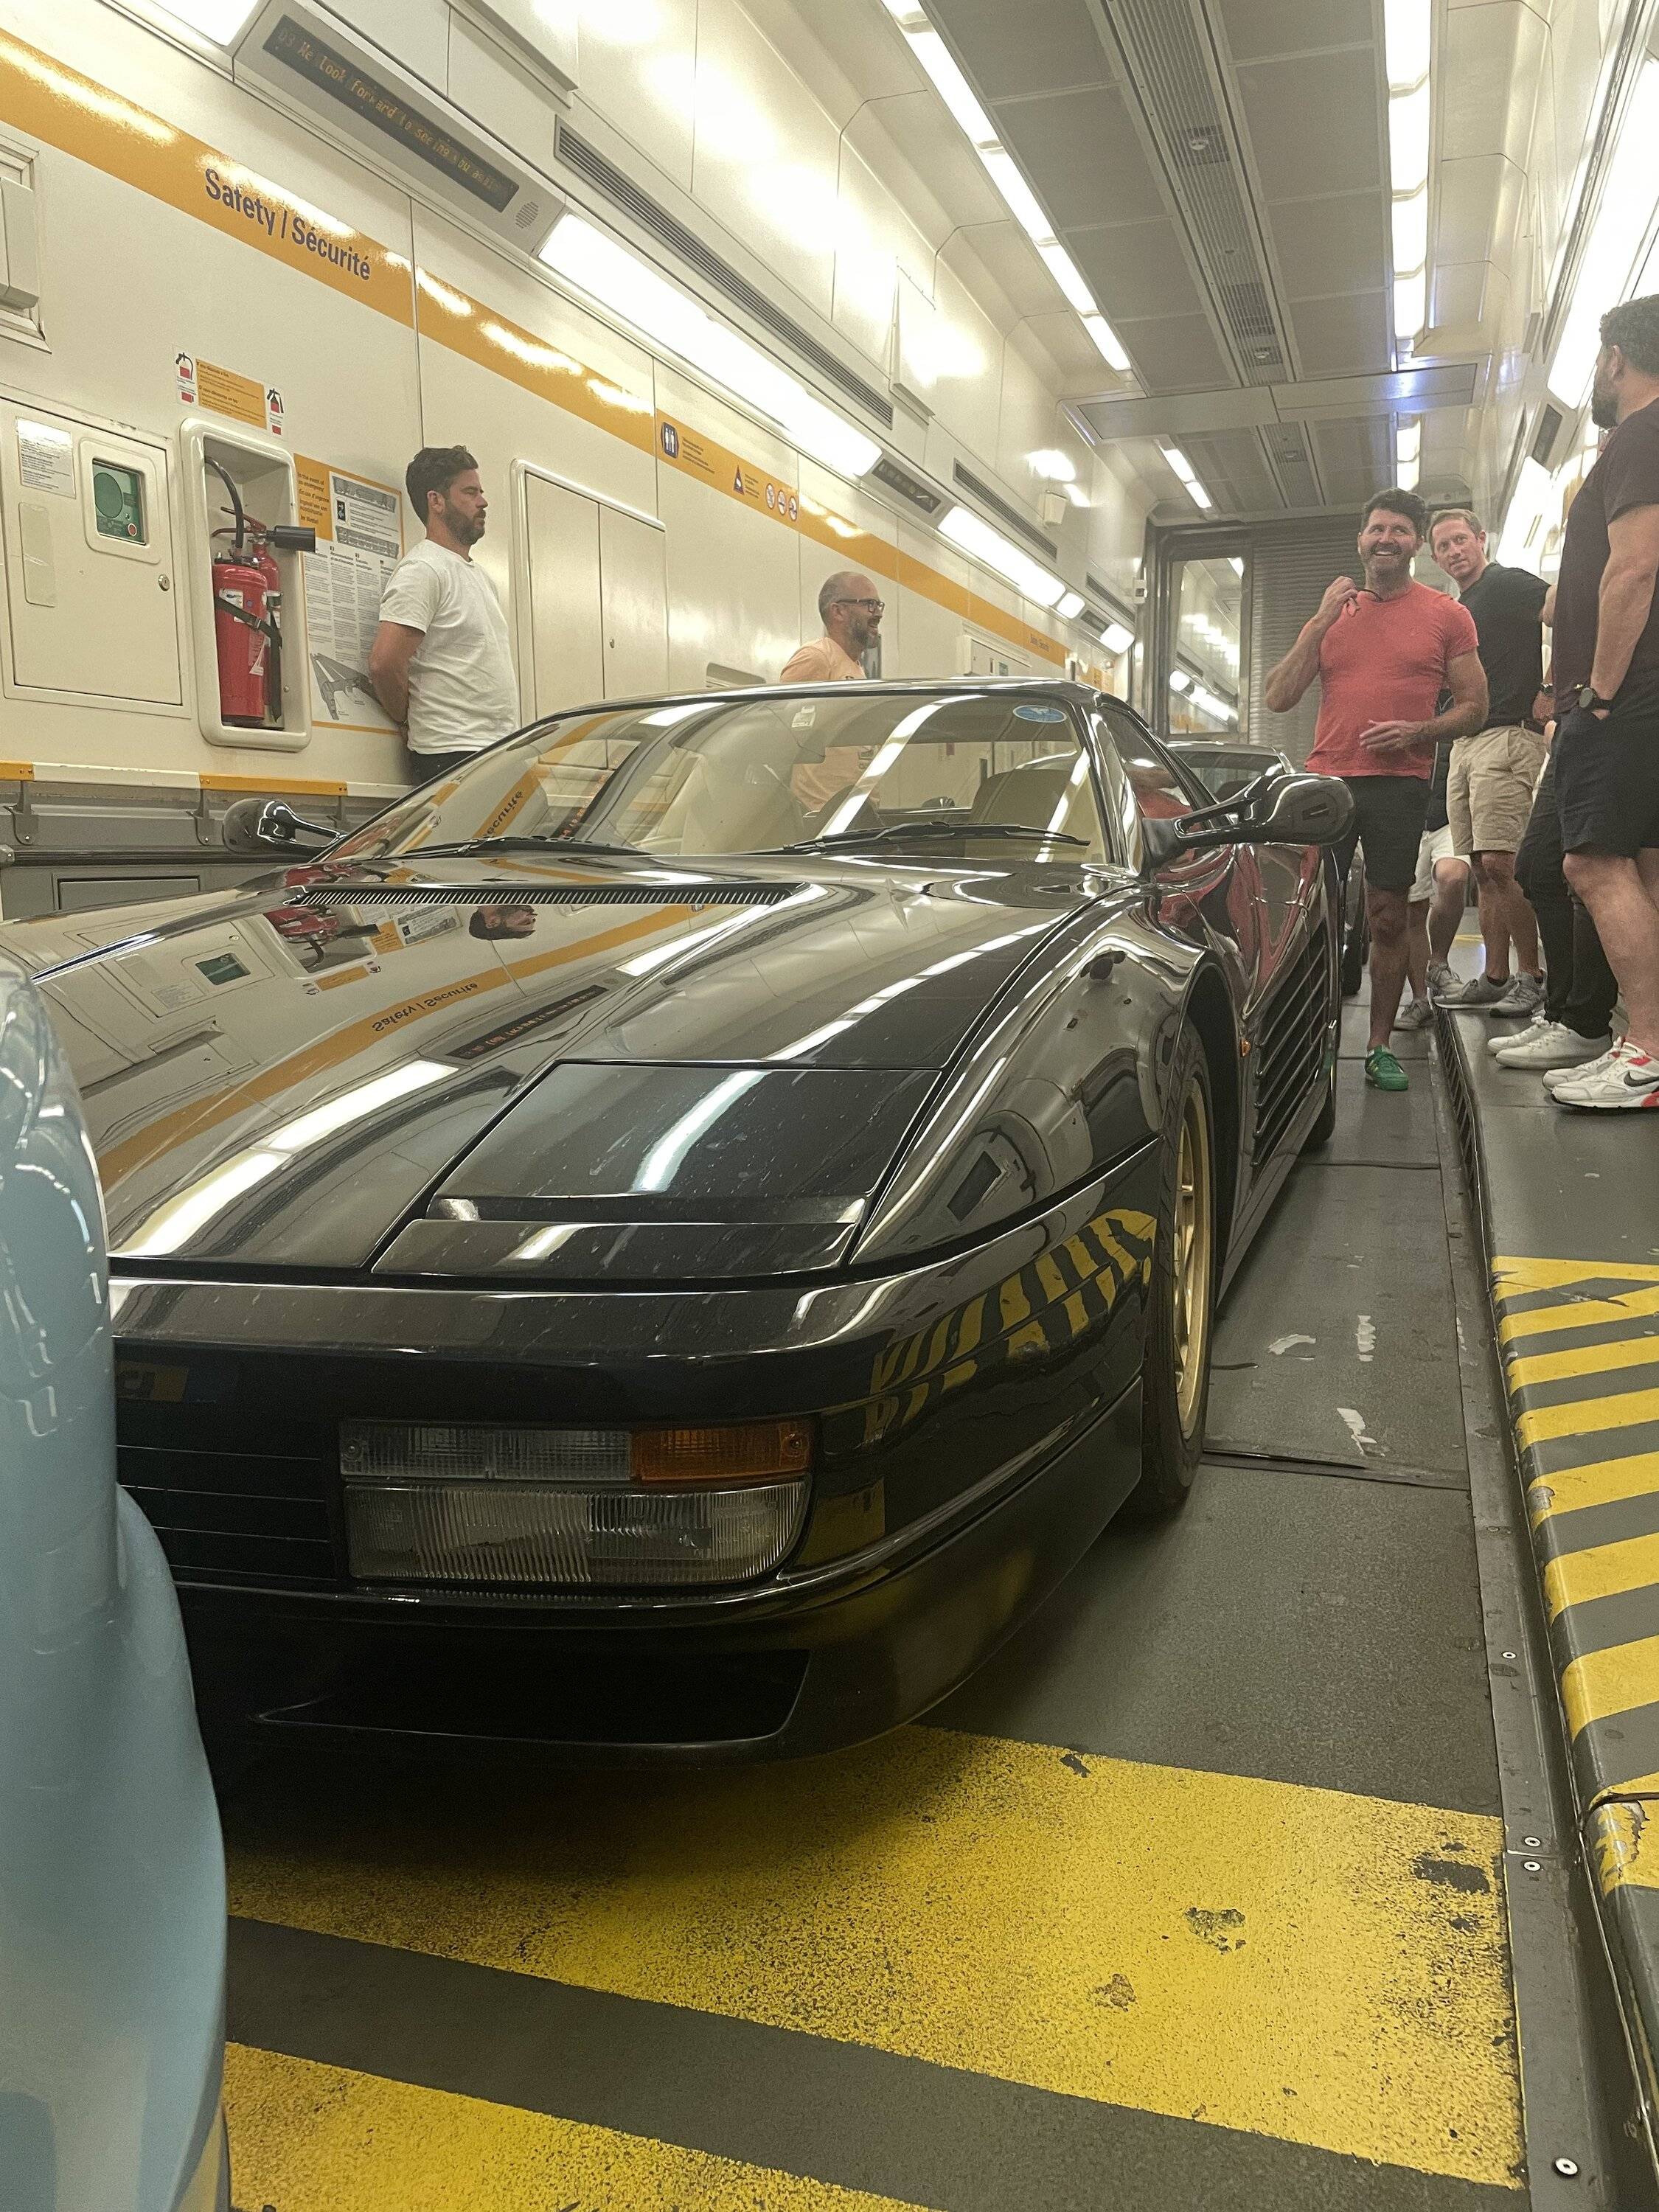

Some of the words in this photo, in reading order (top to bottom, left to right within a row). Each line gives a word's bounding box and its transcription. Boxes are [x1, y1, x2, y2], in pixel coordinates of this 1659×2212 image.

[319, 55, 347, 83] look
[205, 168, 275, 236] Safety
[291, 217, 370, 280] Sécurité
